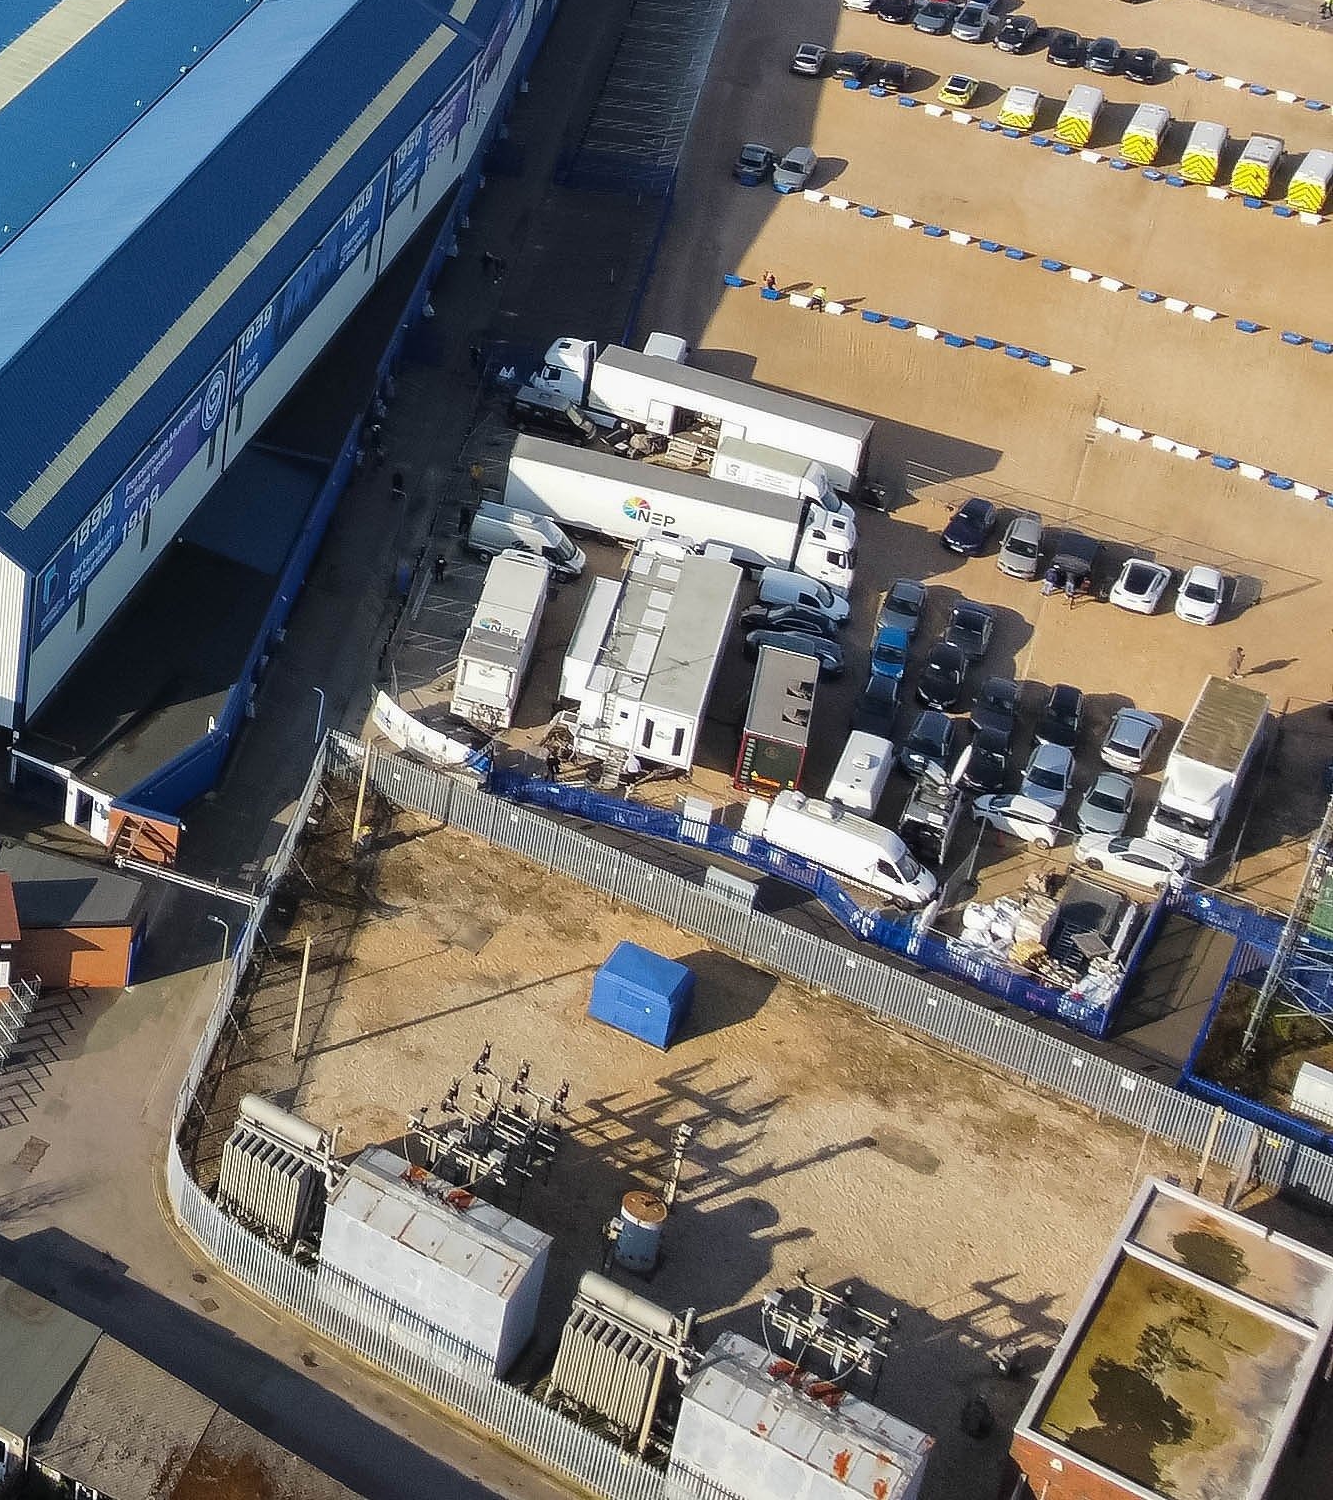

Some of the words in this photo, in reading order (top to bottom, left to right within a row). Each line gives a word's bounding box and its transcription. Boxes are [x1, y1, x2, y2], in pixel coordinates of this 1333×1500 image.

[239, 304, 273, 355] 1939
[72, 490, 114, 555] 1898
[638, 509, 676, 528] NEP
